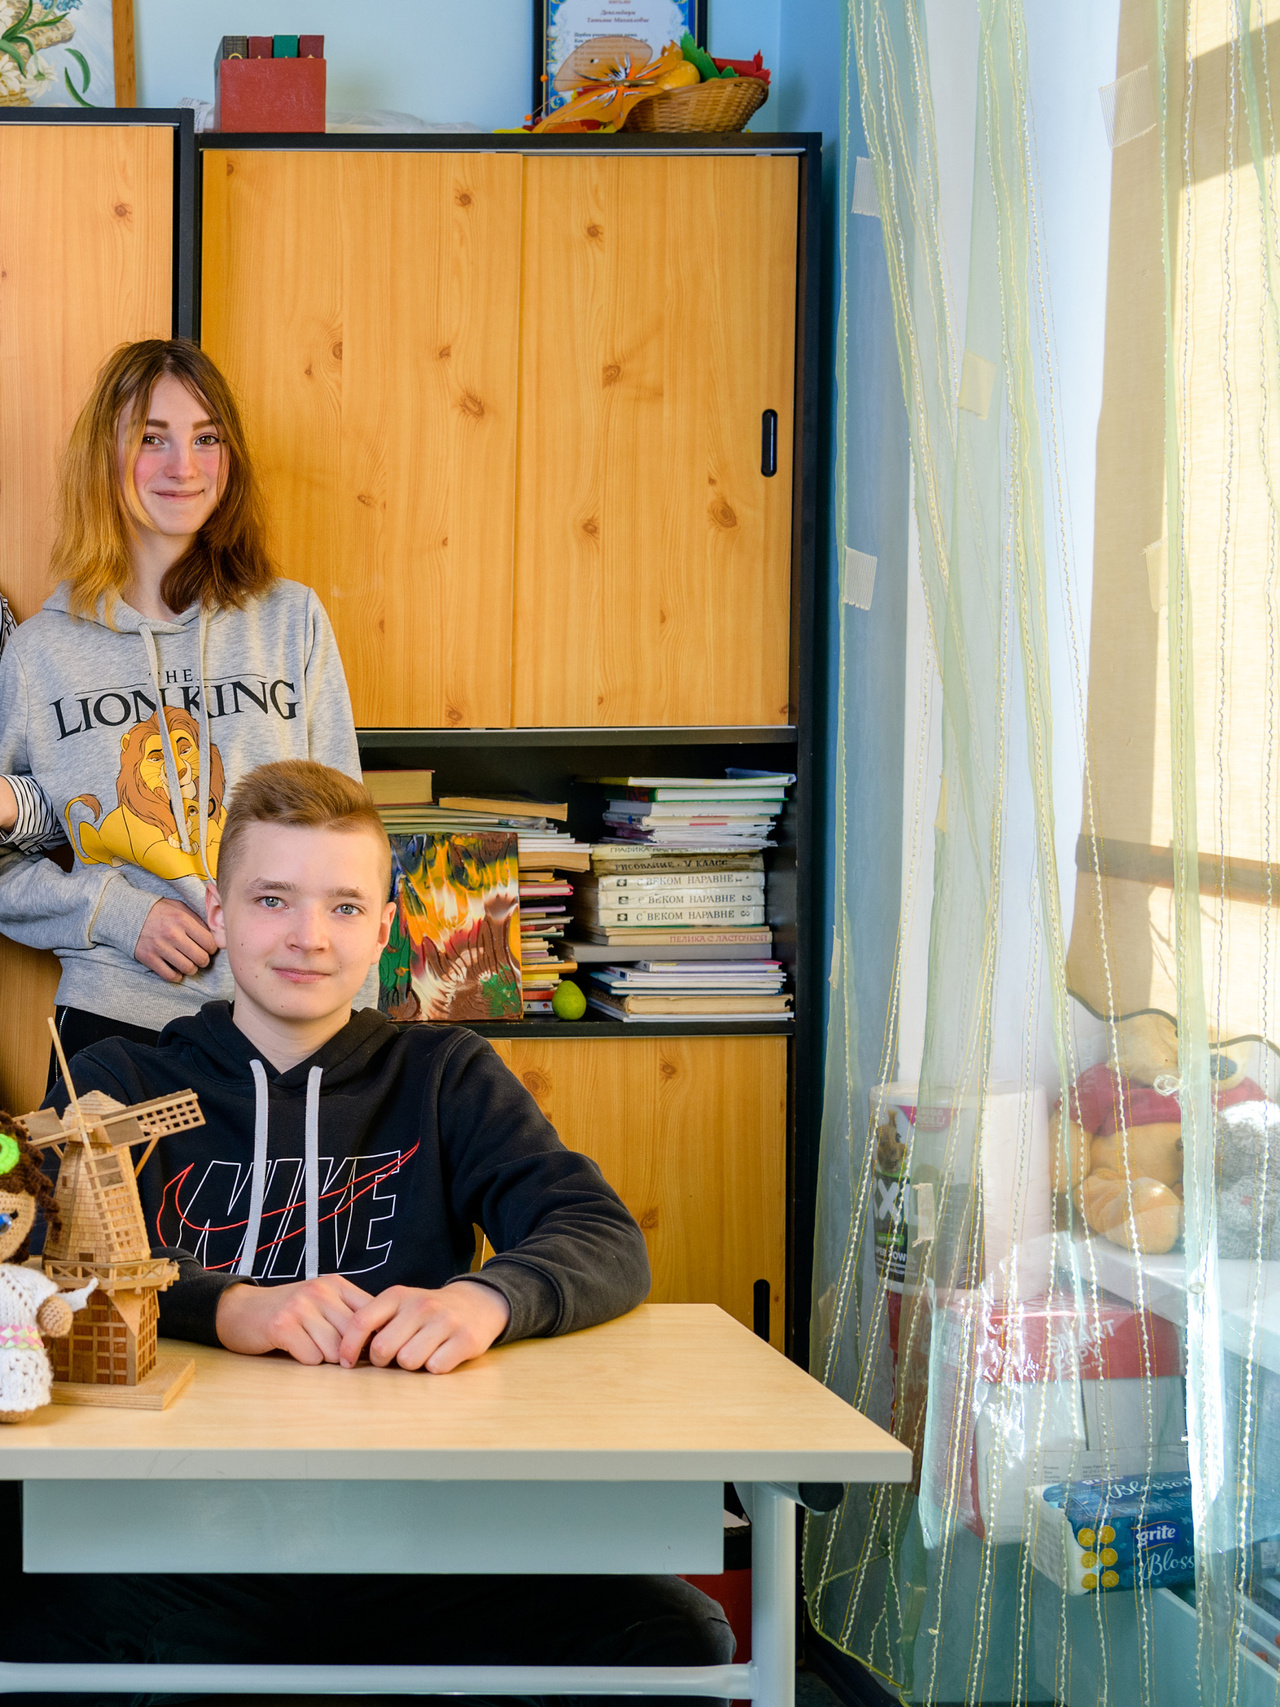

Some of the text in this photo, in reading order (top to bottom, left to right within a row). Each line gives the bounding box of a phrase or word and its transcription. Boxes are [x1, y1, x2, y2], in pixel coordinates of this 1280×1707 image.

[148, 668, 193, 684] HE
[49, 679, 301, 741] LION KING
[615, 861, 674, 872] РИСОВАНИЕ
[684, 858, 728, 868] V КЛАСС
[646, 876, 682, 886] ВЕКОМ
[687, 874, 734, 885] НАРАВНЕ
[648, 894, 684, 905] ВЕКОМ
[689, 894, 736, 904] НАРАВНЕ
[636, 909, 750, 921] С ВЕКОМ НАРАВНЕ 3
[669, 933, 768, 943] ПЕЛИКА С ЛАСТОЧКОЙ
[176, 1150, 401, 1279] NIKE
[1049, 1318, 1115, 1353] SMART
[1052, 1344, 1100, 1370] COPY
[1140, 1524, 1176, 1547] grite
[1143, 1548, 1195, 1580] Bloss
